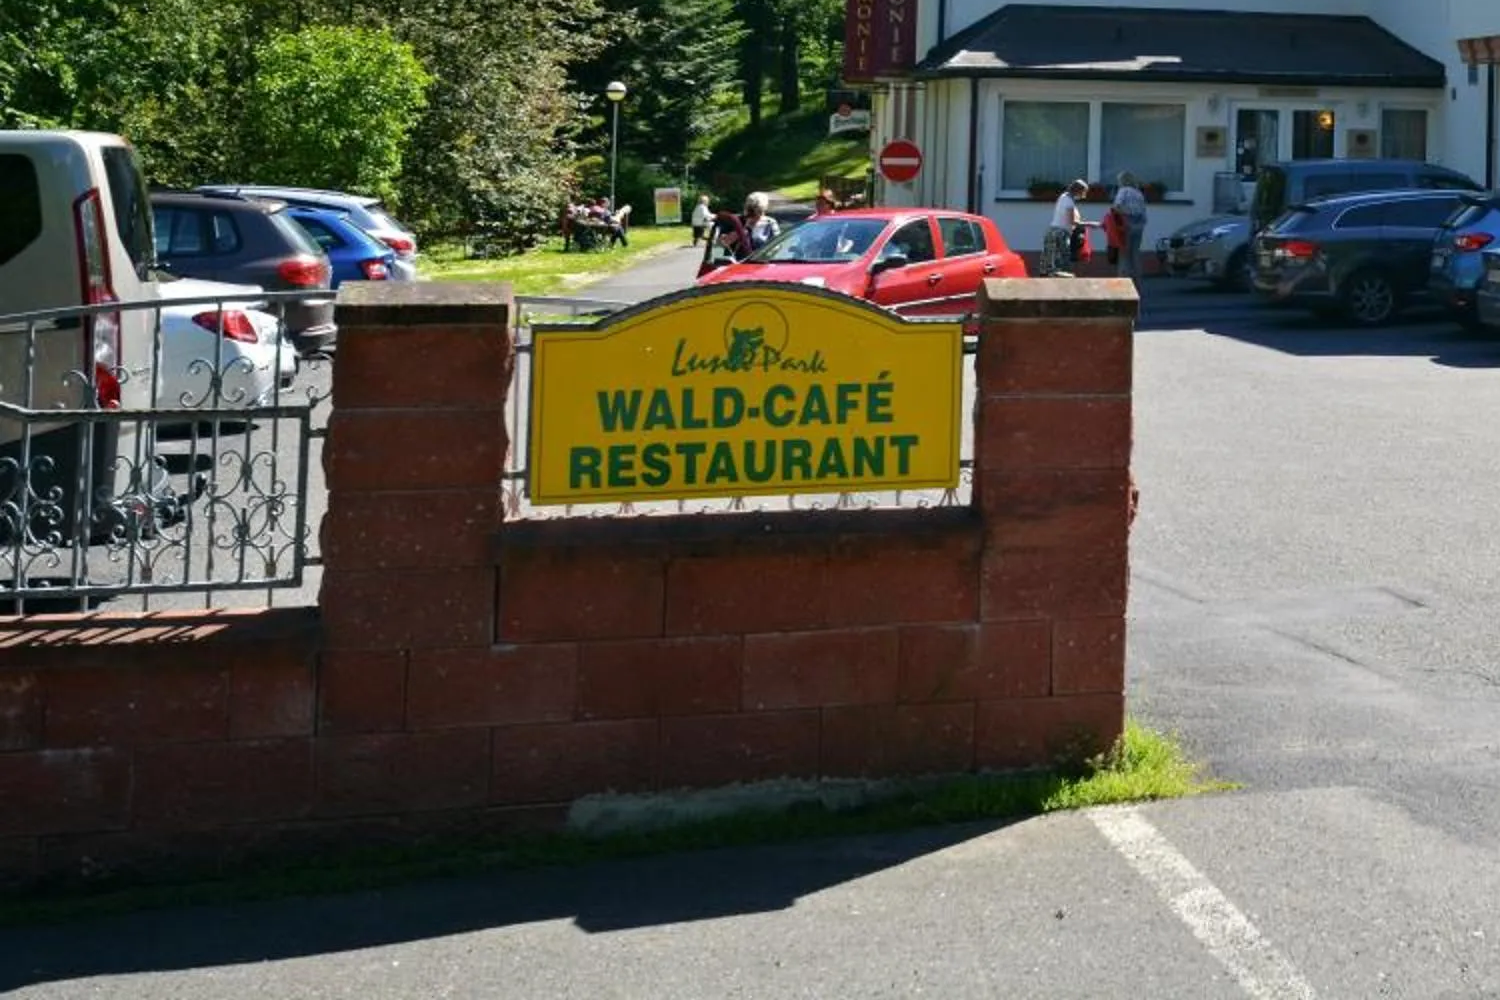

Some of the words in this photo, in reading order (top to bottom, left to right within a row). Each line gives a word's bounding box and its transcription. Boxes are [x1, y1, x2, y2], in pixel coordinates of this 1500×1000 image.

[763, 344, 827, 373] Park
[597, 371, 894, 432] WALD-CAFÉ
[570, 436, 919, 488] RESTAURANT
